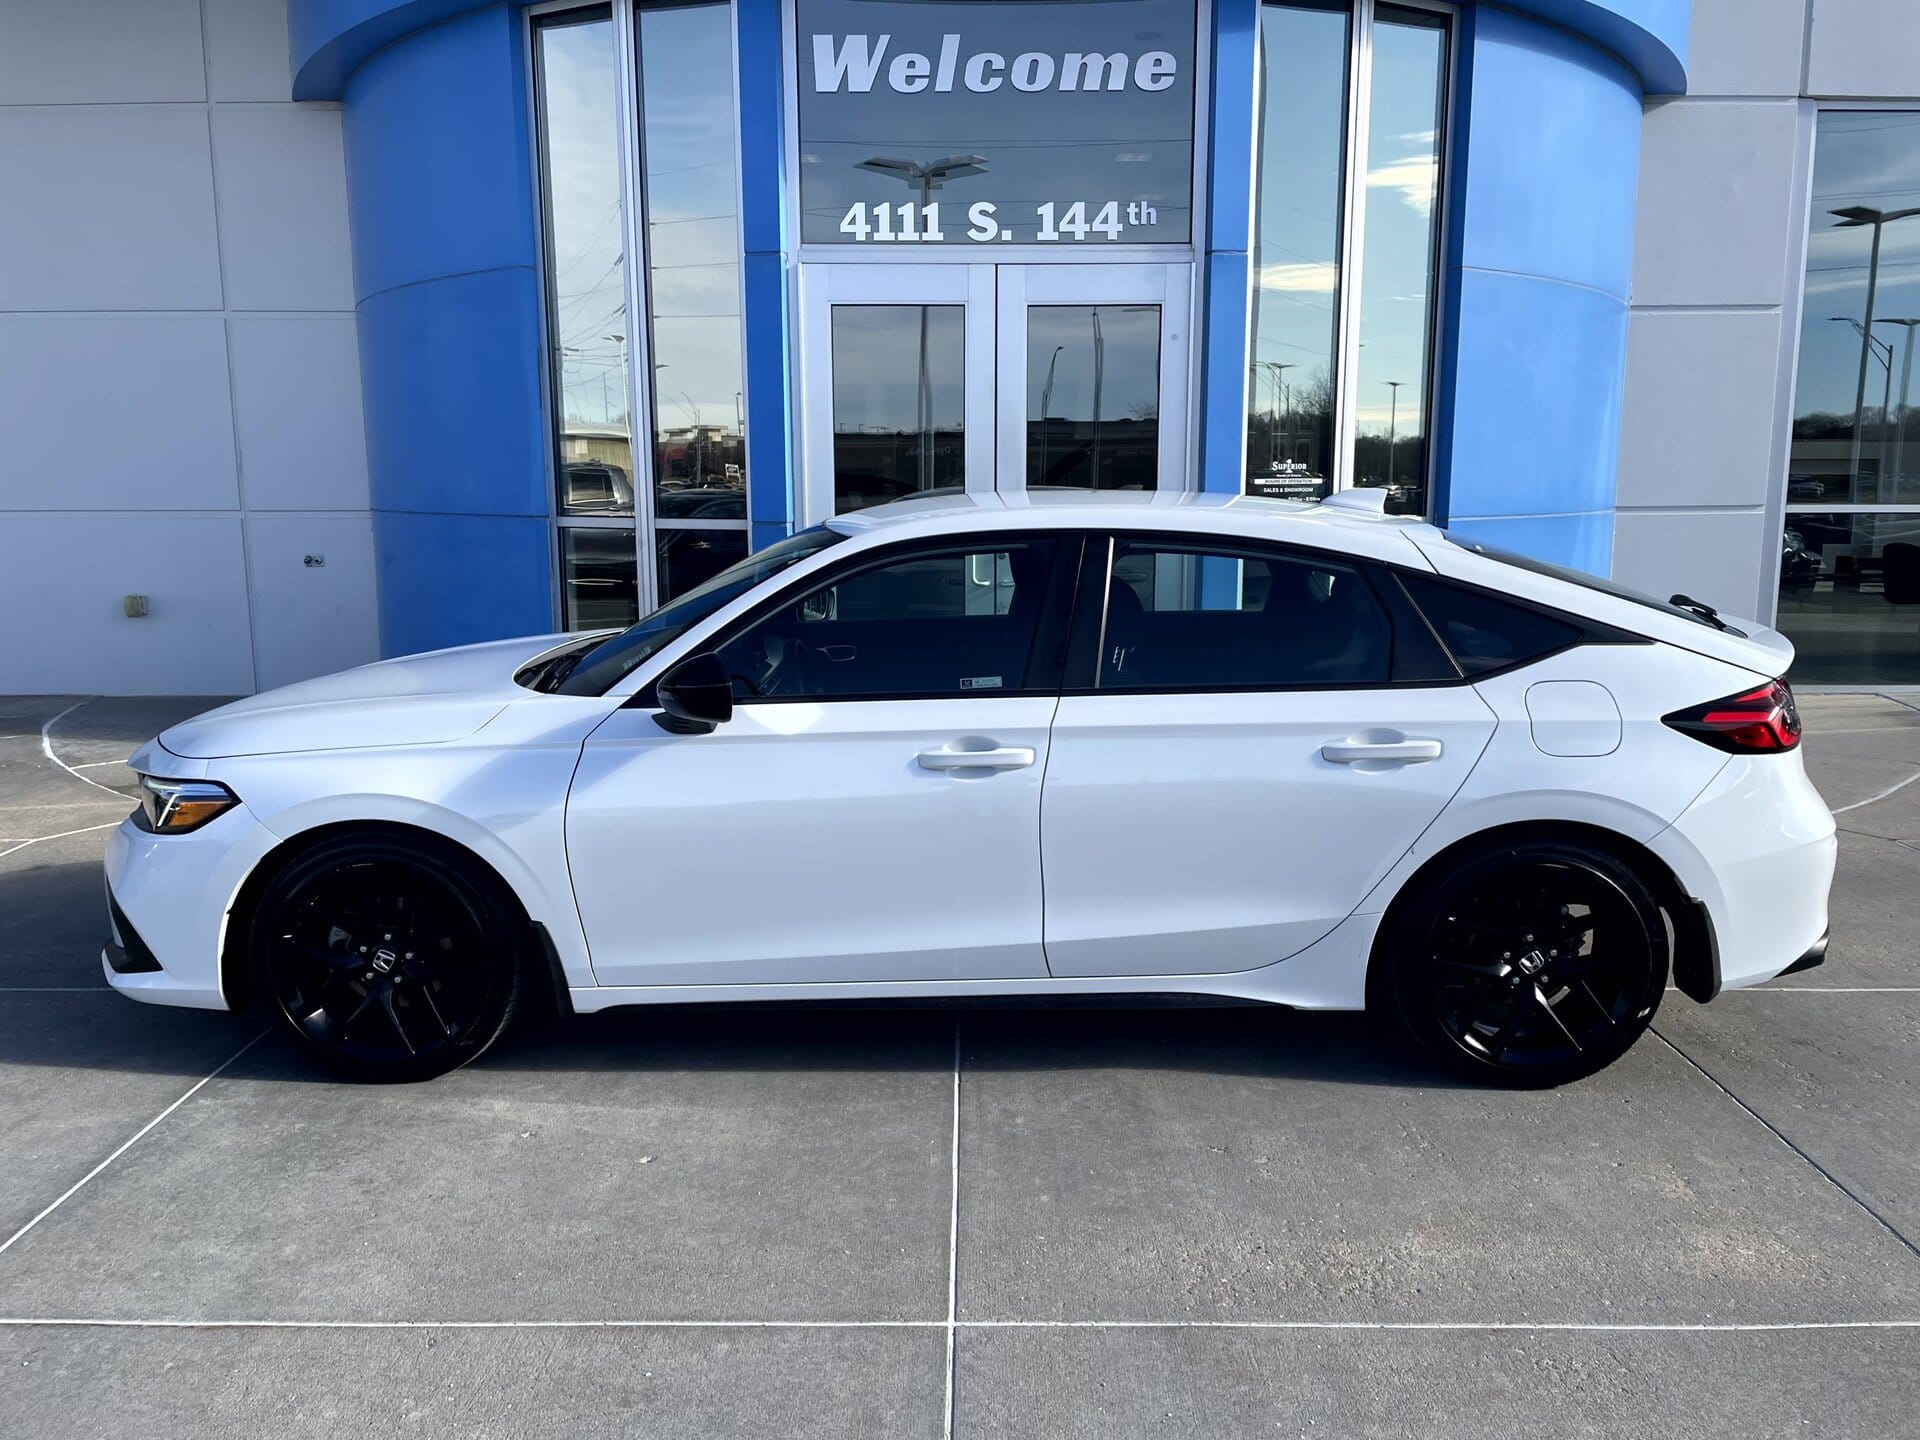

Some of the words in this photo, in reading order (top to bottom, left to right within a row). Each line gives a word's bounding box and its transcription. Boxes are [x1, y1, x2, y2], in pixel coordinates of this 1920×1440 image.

[812, 34, 1177, 93] Welcome
[839, 201, 944, 241] 4111
[967, 201, 1012, 241] S.
